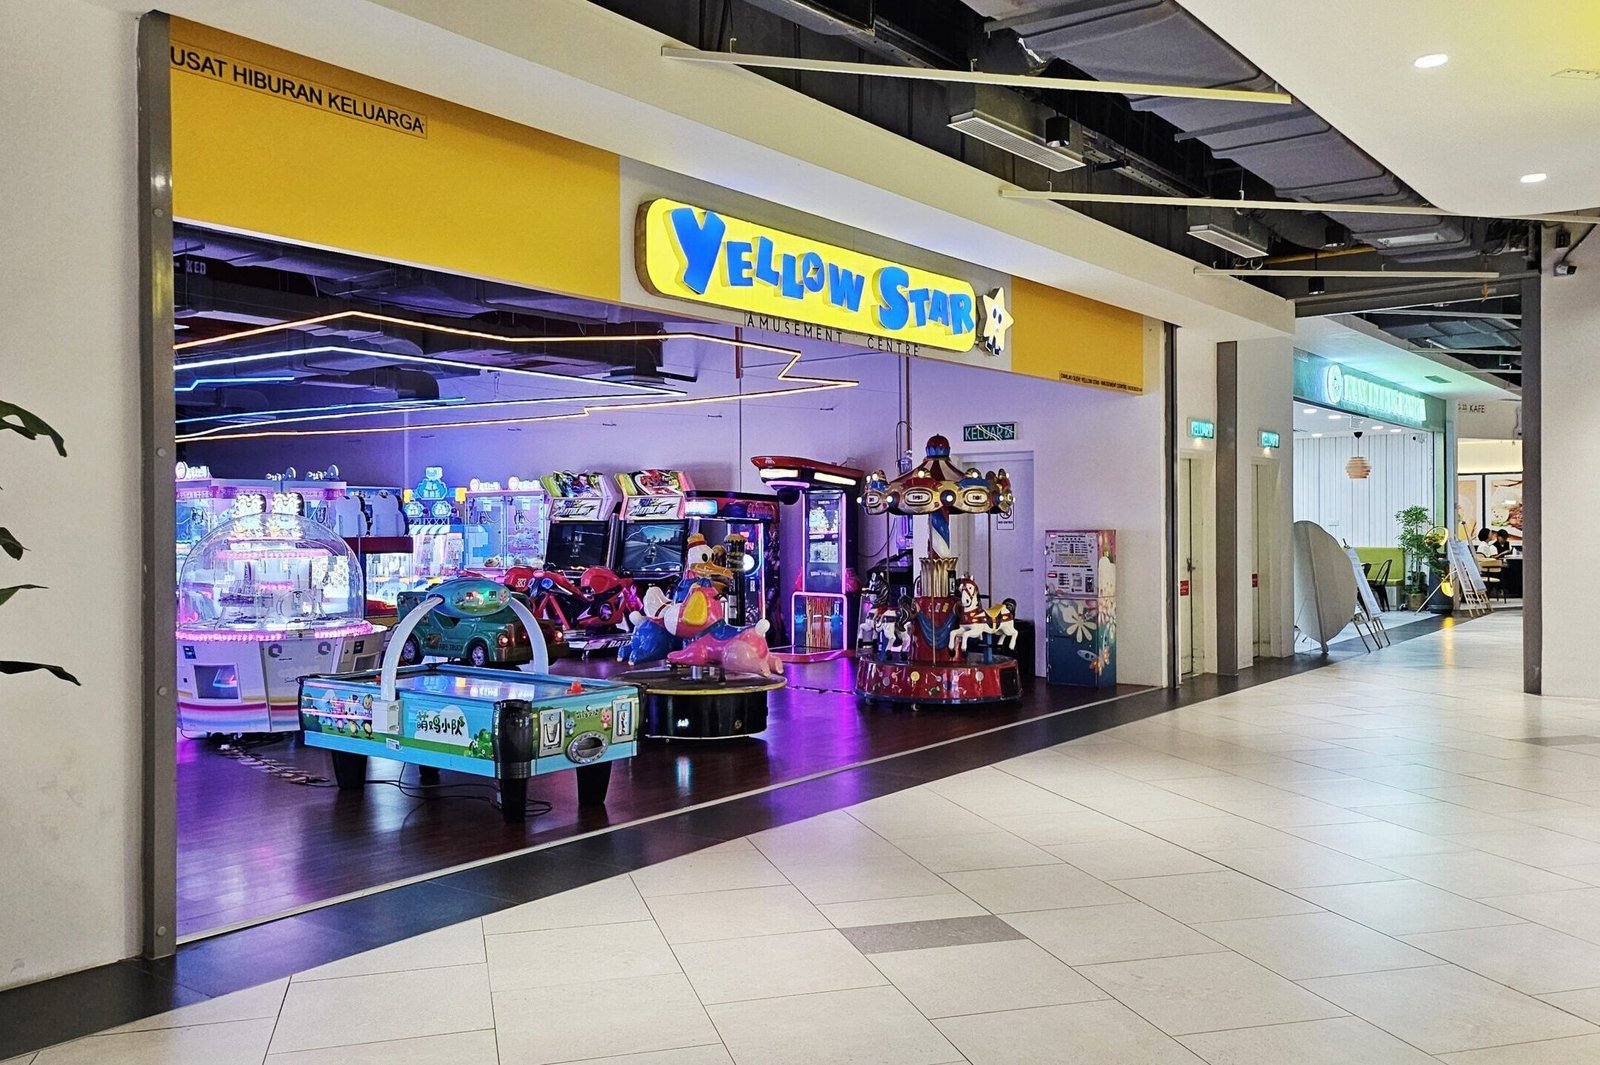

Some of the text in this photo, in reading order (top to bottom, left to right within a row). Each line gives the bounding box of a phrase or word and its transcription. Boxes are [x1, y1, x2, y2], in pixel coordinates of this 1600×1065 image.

[170, 46, 424, 134] USAT HIBURAN KELUARGA
[669, 206, 976, 335] YELLOW STAR
[746, 315, 920, 357] AMUSEMENT CENTRE
[964, 426, 1003, 440] KELUAR
